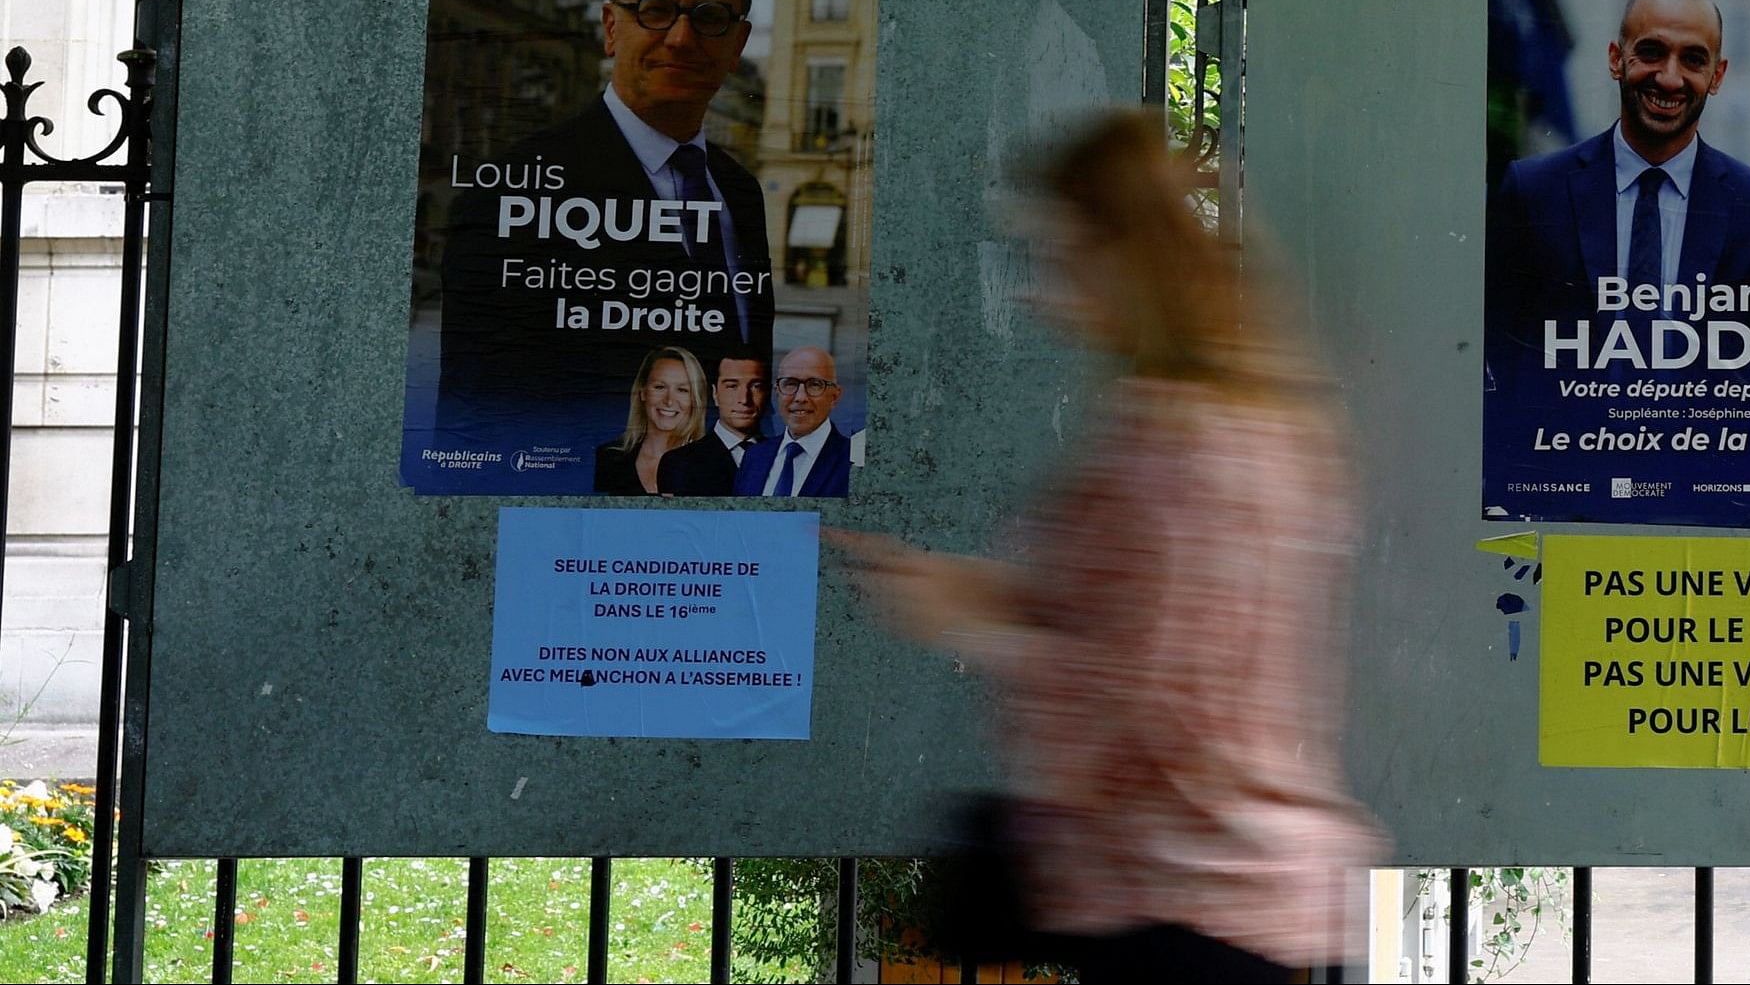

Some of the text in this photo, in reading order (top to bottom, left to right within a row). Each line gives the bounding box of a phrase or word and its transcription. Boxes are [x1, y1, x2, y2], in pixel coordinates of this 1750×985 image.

[451, 154, 565, 191] Louis
[498, 195, 722, 250] PIQUET
[501, 258, 771, 300] Faites gagner
[555, 297, 726, 333] la Droite
[1558, 379, 1621, 398] Votre
[1626, 379, 1708, 402] député
[1608, 407, 1680, 421] Suppléante
[1534, 427, 1570, 451] Le
[1578, 428, 1664, 451] choix
[1670, 428, 1710, 452] de
[1718, 428, 1748, 452] la
[448, 461, 482, 470] DROITE
[1507, 483, 1591, 492] RENAISSANCE
[1616, 482, 1672, 490] MOUVEMENT
[1693, 484, 1742, 493] HORIZONS
[554, 559, 760, 577] SEULE CANDIDATURE DE
[590, 581, 722, 598] LA DROITE UNIE
[1584, 570, 1645, 596] PAS
[1656, 570, 1723, 596] UNE
[594, 603, 717, 618] DANS LE 16ième
[1606, 617, 1698, 643] POUR
[1709, 617, 1743, 643] LE
[539, 647, 766, 665] DITES NON AUX ALLIANCES
[501, 668, 545, 683] AVEC
[665, 671, 677, 684] A
[1584, 661, 1645, 687] PAS
[1656, 661, 1723, 687] UNE
[1628, 707, 1721, 734] POUR
